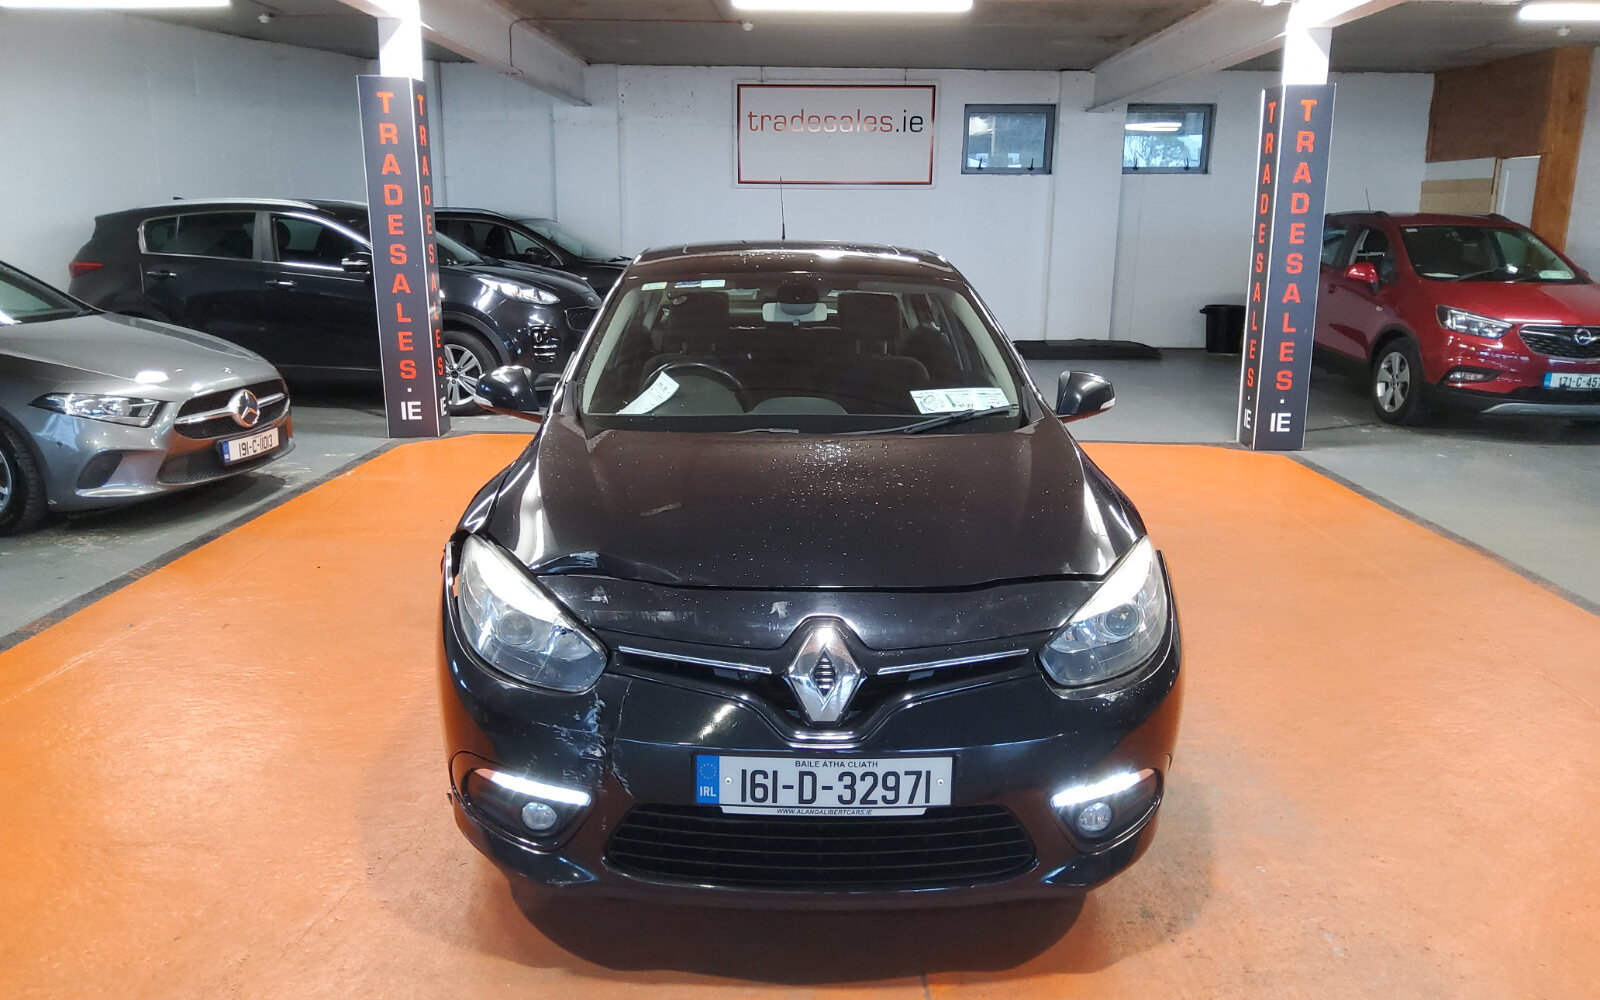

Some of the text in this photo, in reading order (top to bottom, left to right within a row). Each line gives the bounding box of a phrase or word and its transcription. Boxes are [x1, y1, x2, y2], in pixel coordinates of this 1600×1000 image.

[747, 109, 924, 133] tradesales.ie
[795, 760, 819, 768] BAILE
[847, 761, 878, 769] CLIATH
[699, 785, 717, 797] IRL
[740, 769, 932, 805] 161-D-32971
